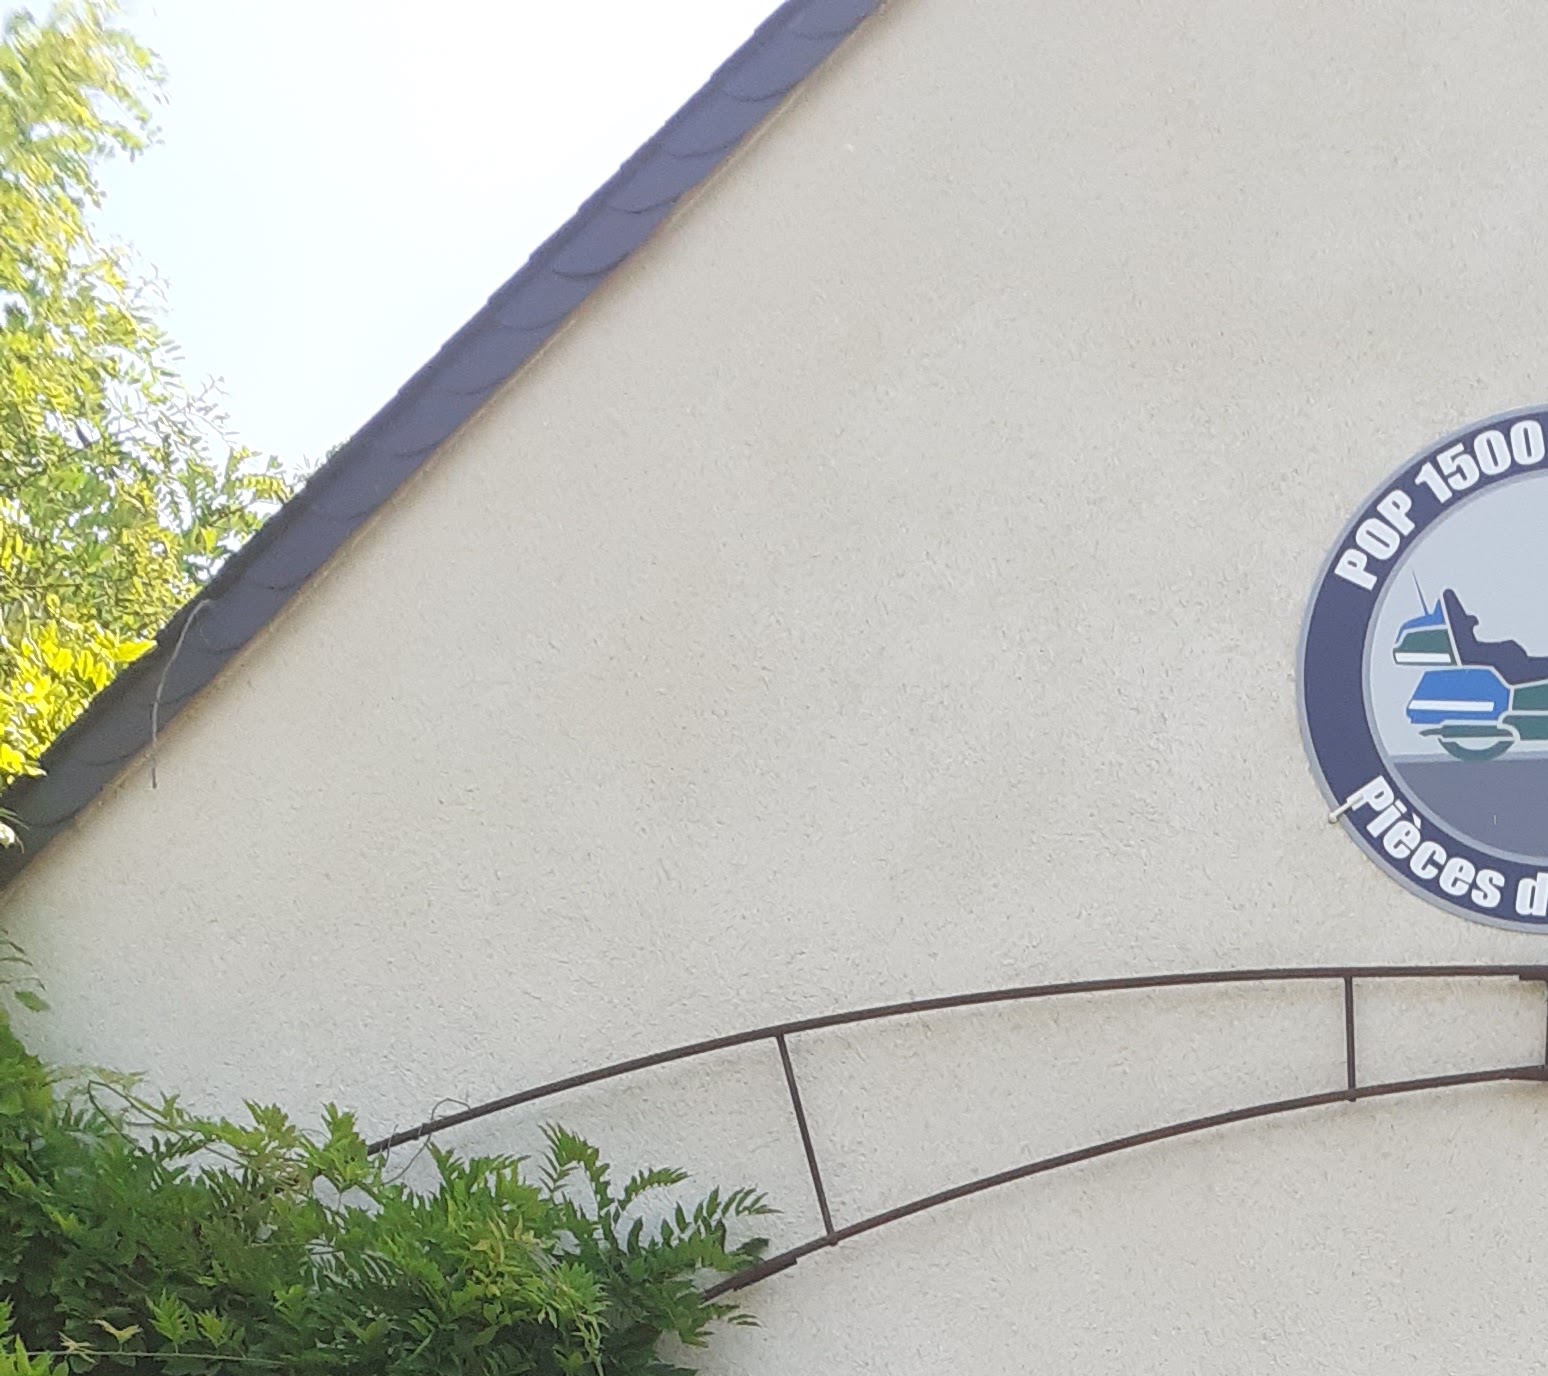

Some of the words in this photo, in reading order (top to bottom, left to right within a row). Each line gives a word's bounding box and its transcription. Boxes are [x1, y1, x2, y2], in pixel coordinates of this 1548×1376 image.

[1334, 489, 1415, 591] POP
[1414, 419, 1546, 505] 1500
[1346, 774, 1505, 909] Pièces
